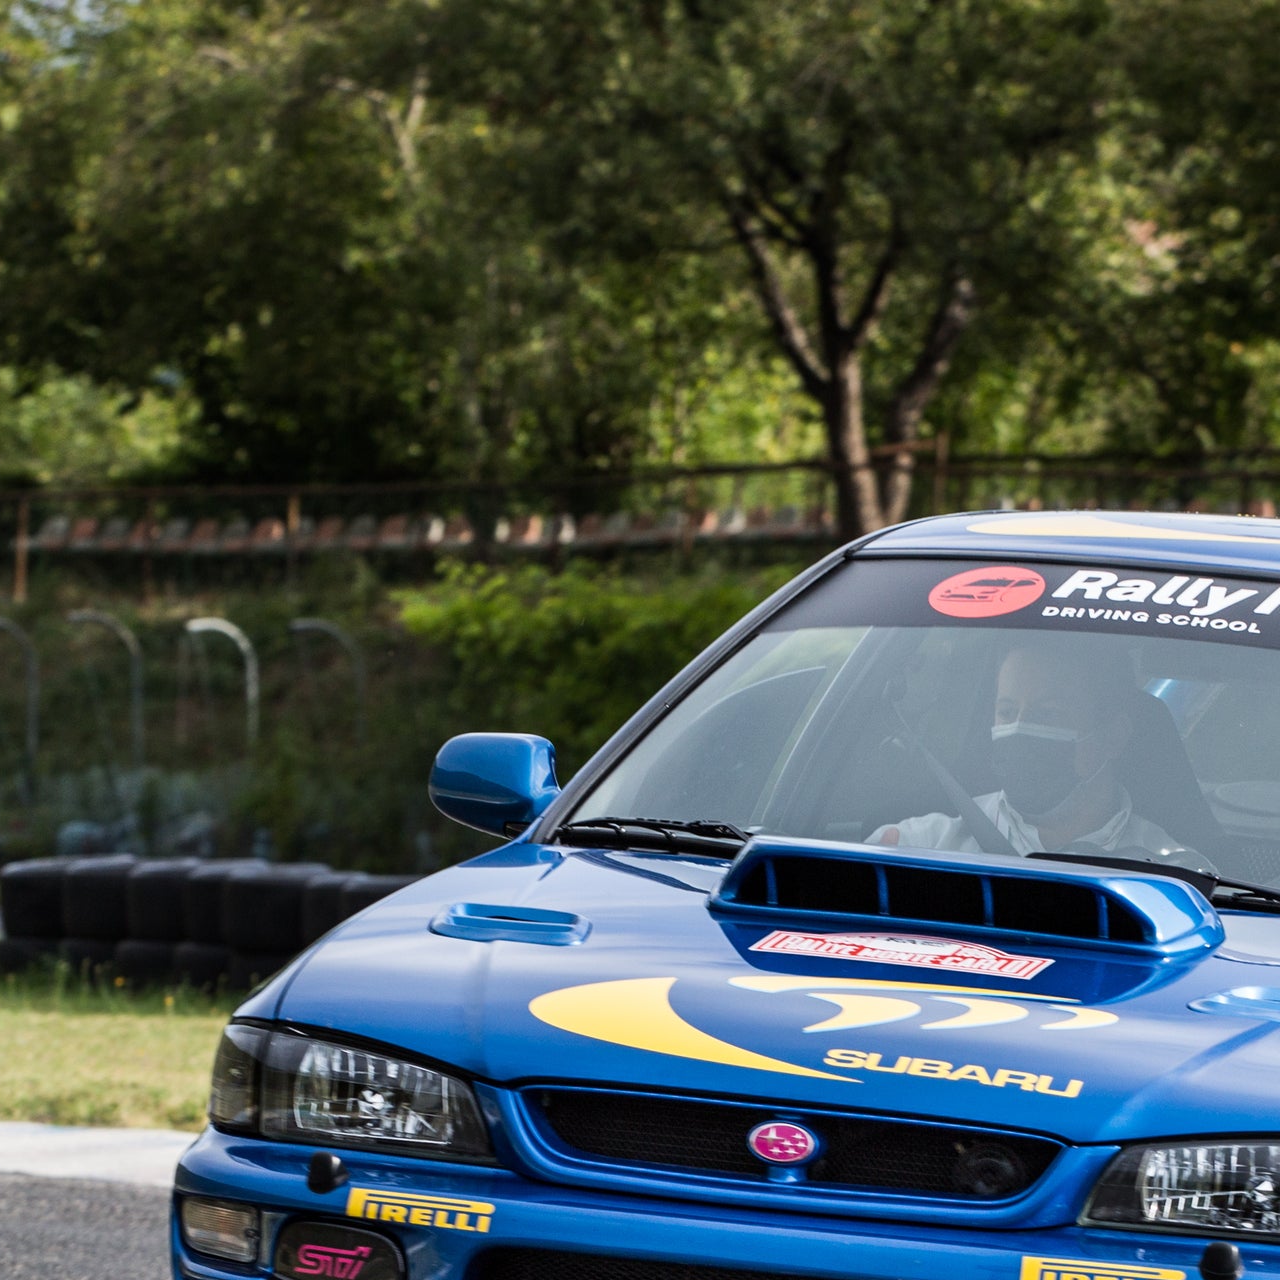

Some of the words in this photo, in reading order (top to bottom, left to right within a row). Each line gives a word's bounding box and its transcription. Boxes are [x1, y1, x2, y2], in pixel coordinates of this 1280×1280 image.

[1051, 569, 1258, 616] Rally
[1041, 605, 1149, 624] DRIVING
[1154, 613, 1262, 634] SCHOOL
[823, 1048, 1084, 1098] SUBARU
[346, 1188, 495, 1233] PIRELLI
